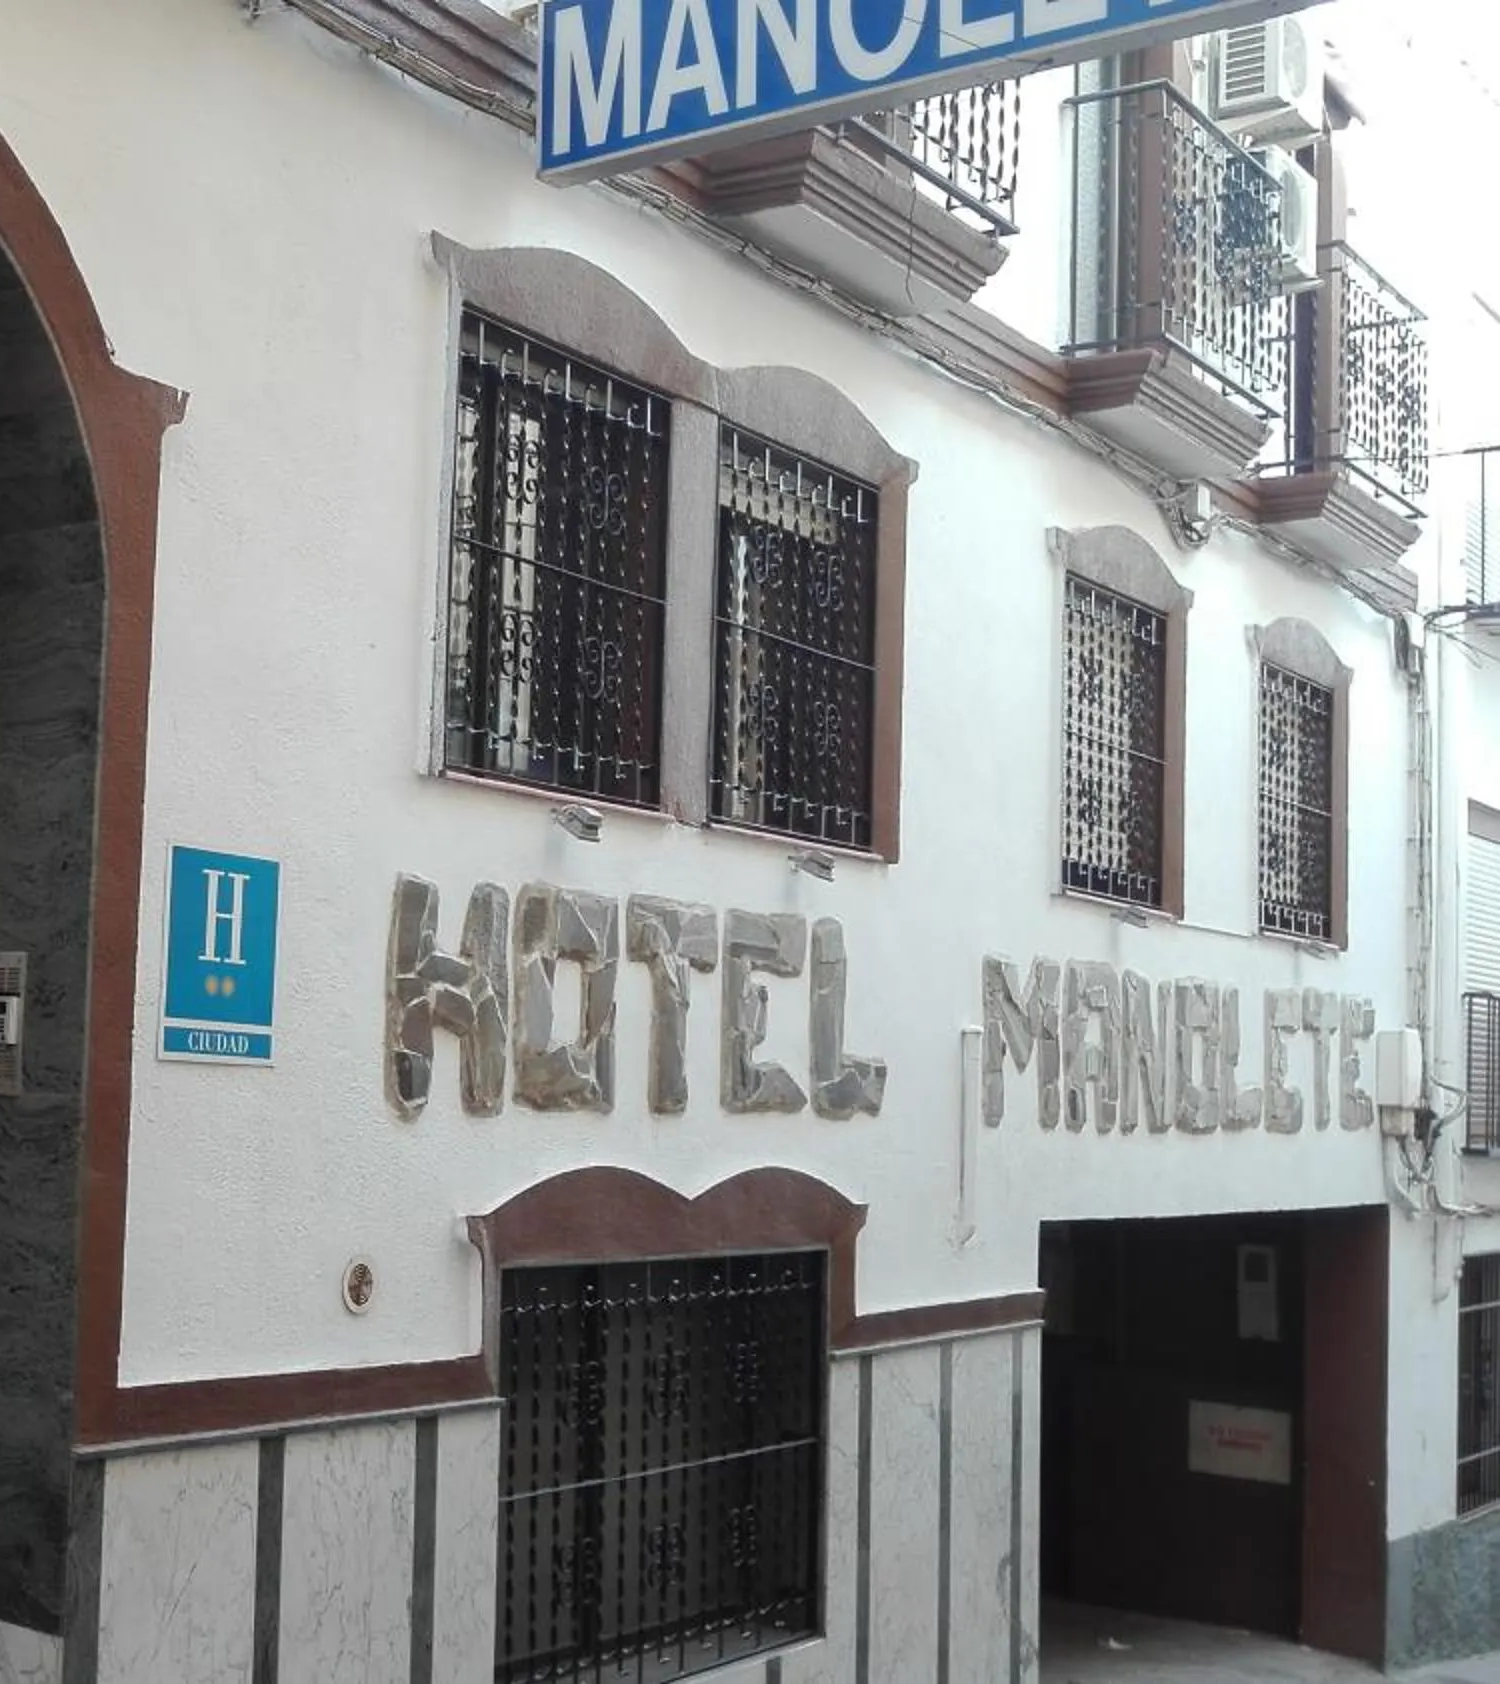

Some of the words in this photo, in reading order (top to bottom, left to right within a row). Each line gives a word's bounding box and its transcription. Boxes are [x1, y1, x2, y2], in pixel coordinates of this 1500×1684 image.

[198, 868, 250, 966] H
[188, 1031, 249, 1054] CIUDAD
[384, 871, 888, 1122] HOTEL
[981, 955, 1376, 1135] MANOLETE
